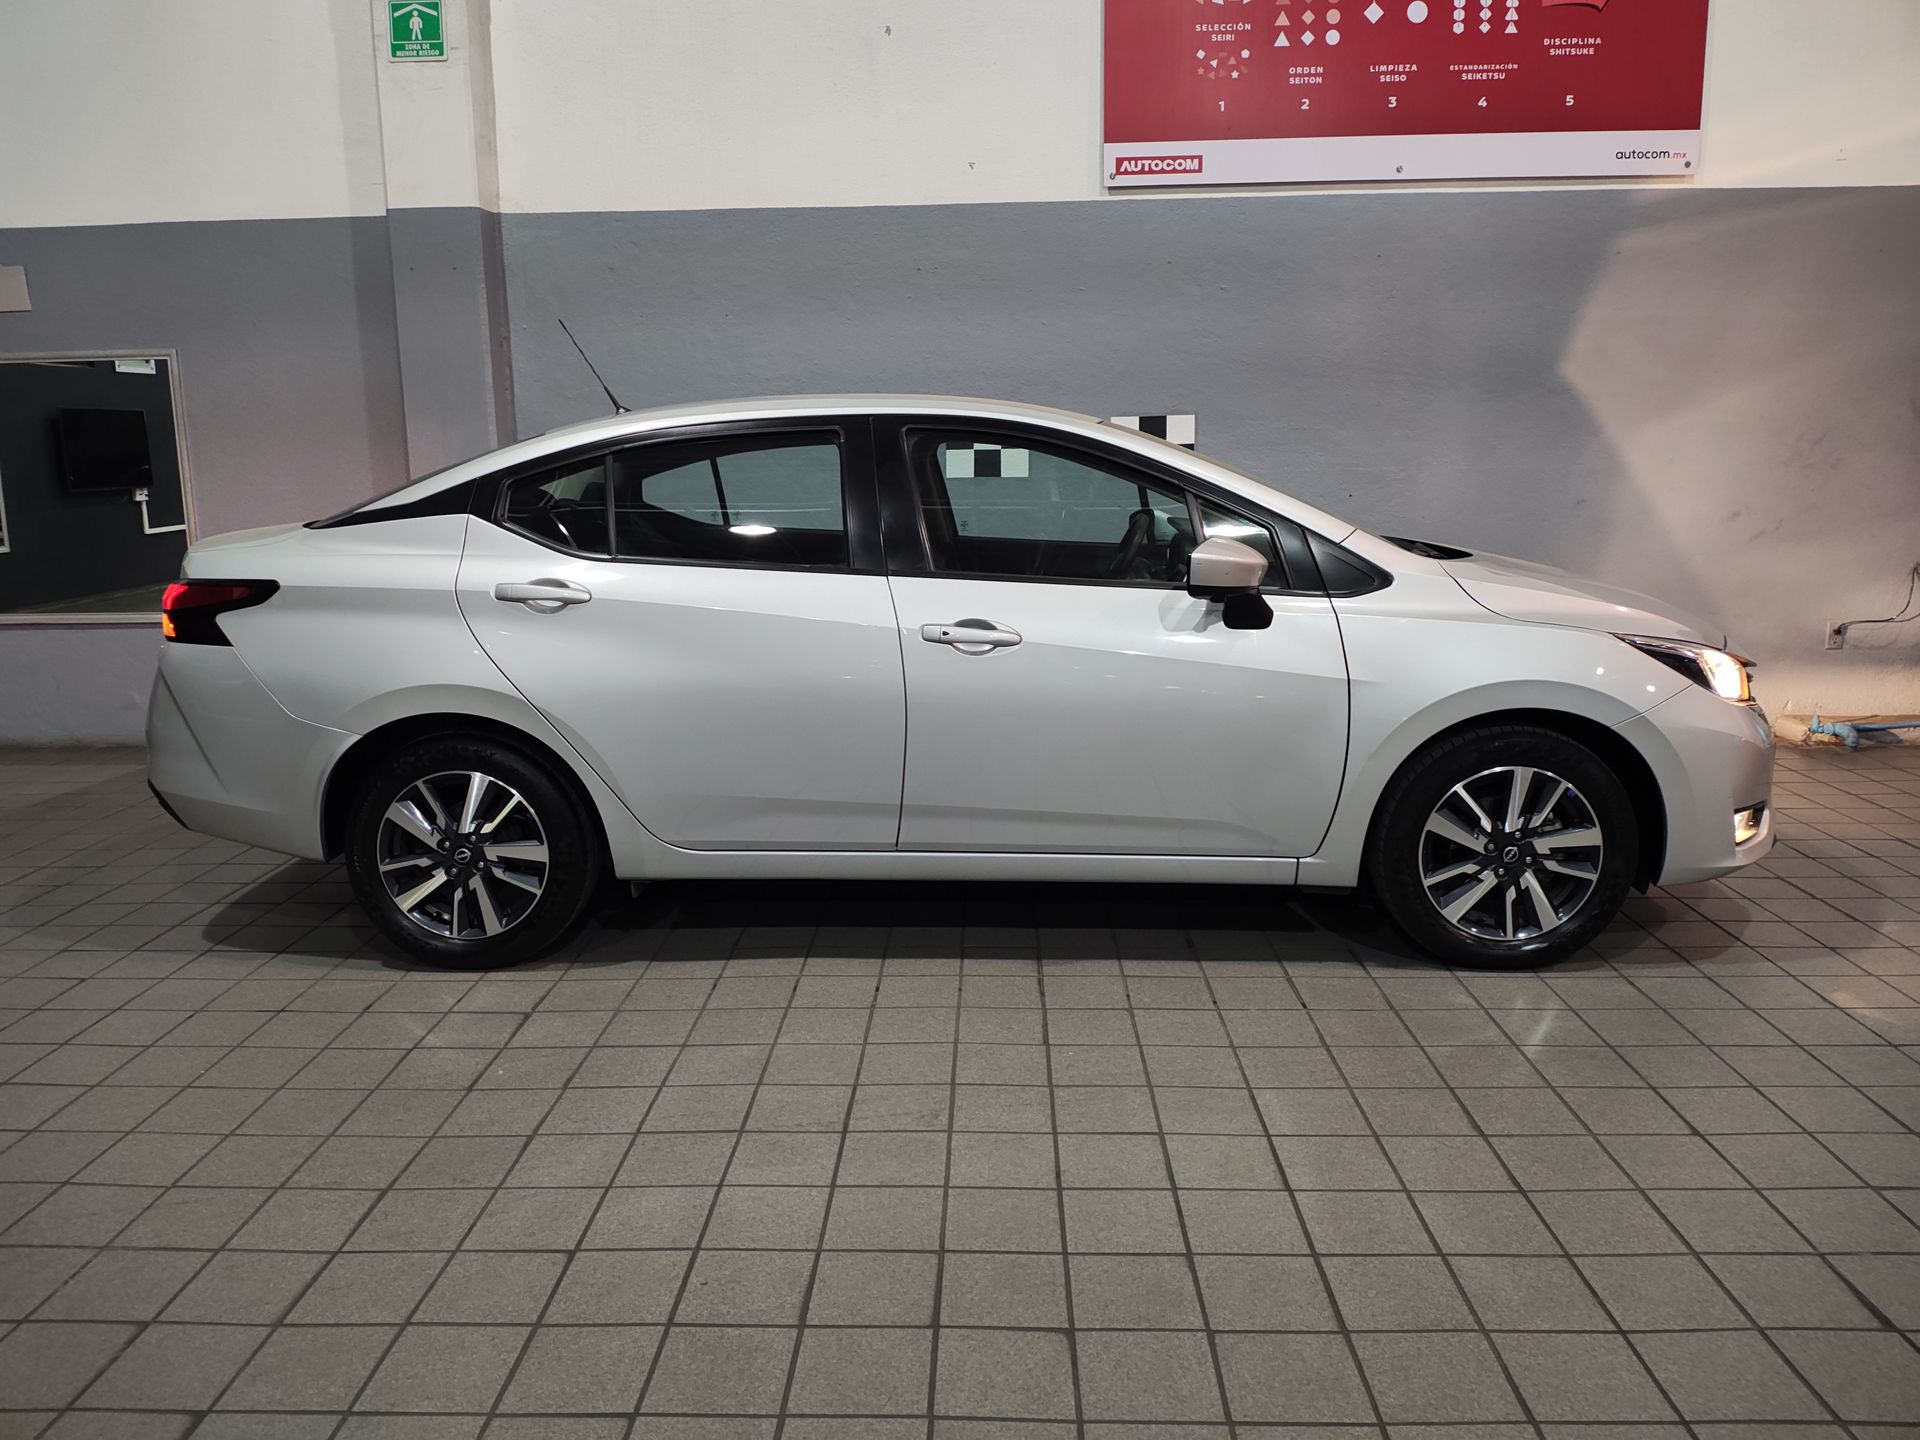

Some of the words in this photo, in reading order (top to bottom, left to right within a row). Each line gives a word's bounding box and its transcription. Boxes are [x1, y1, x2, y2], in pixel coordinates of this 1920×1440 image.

[1195, 21, 1252, 31] SELECCIÓN
[1211, 33, 1235, 41] SEIRI
[1543, 37, 1602, 46] DISCIPLINA
[1549, 47, 1595, 56] SHITSUKE
[1288, 66, 1324, 74] ORDEN
[1370, 64, 1418, 72] LIMPIEZA
[1449, 63, 1519, 71] ESTANDARIZACIÓN
[1289, 76, 1323, 85] SEITON
[1379, 74, 1407, 82] SEISO
[1461, 72, 1506, 81] SEIKETSU
[1300, 98, 1310, 110] 2
[1388, 96, 1397, 108] 3
[1477, 96, 1488, 108] 4
[1565, 94, 1575, 106] 5
[1218, 100, 1225, 112] 1
[1120, 158, 1199, 172] AUTOCOM
